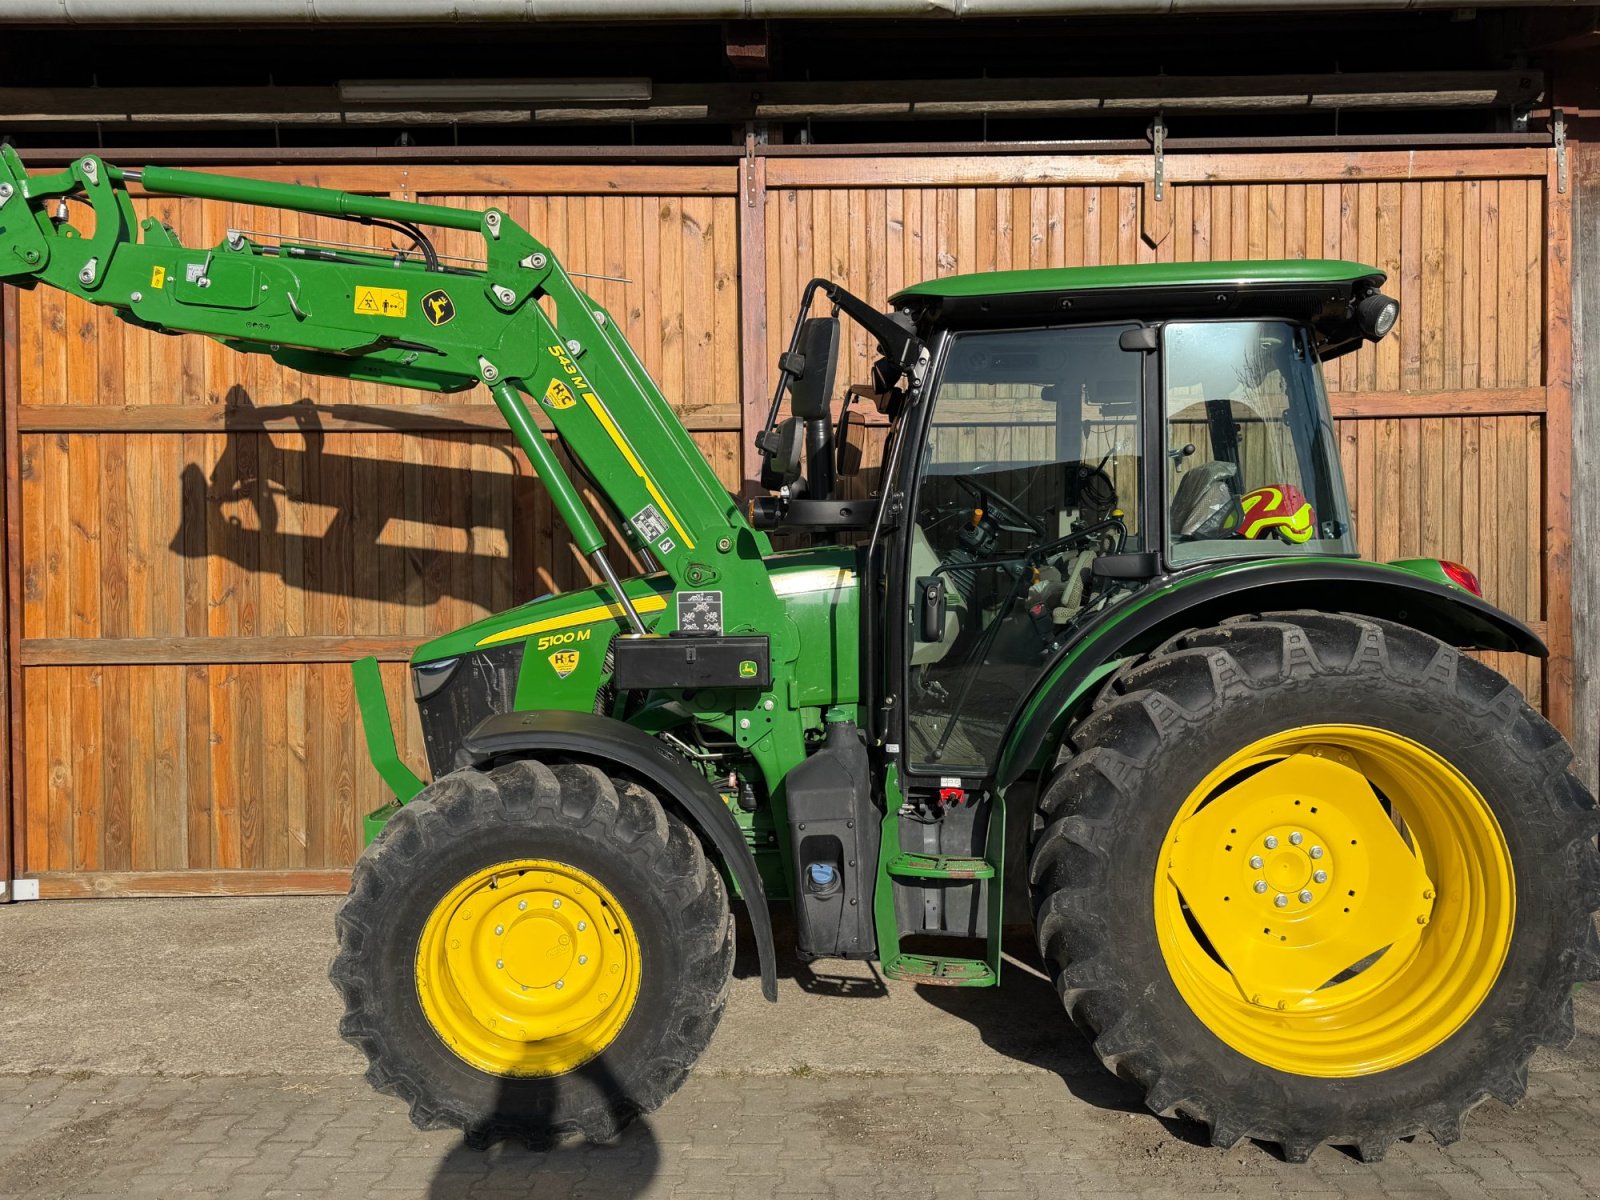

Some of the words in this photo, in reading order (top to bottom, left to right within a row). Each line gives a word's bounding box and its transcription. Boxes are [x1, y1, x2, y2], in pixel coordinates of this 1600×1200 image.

[547, 345, 577, 374] 543
[571, 376, 588, 389] M
[537, 632, 575, 650] 5100
[576, 629, 591, 641] M
